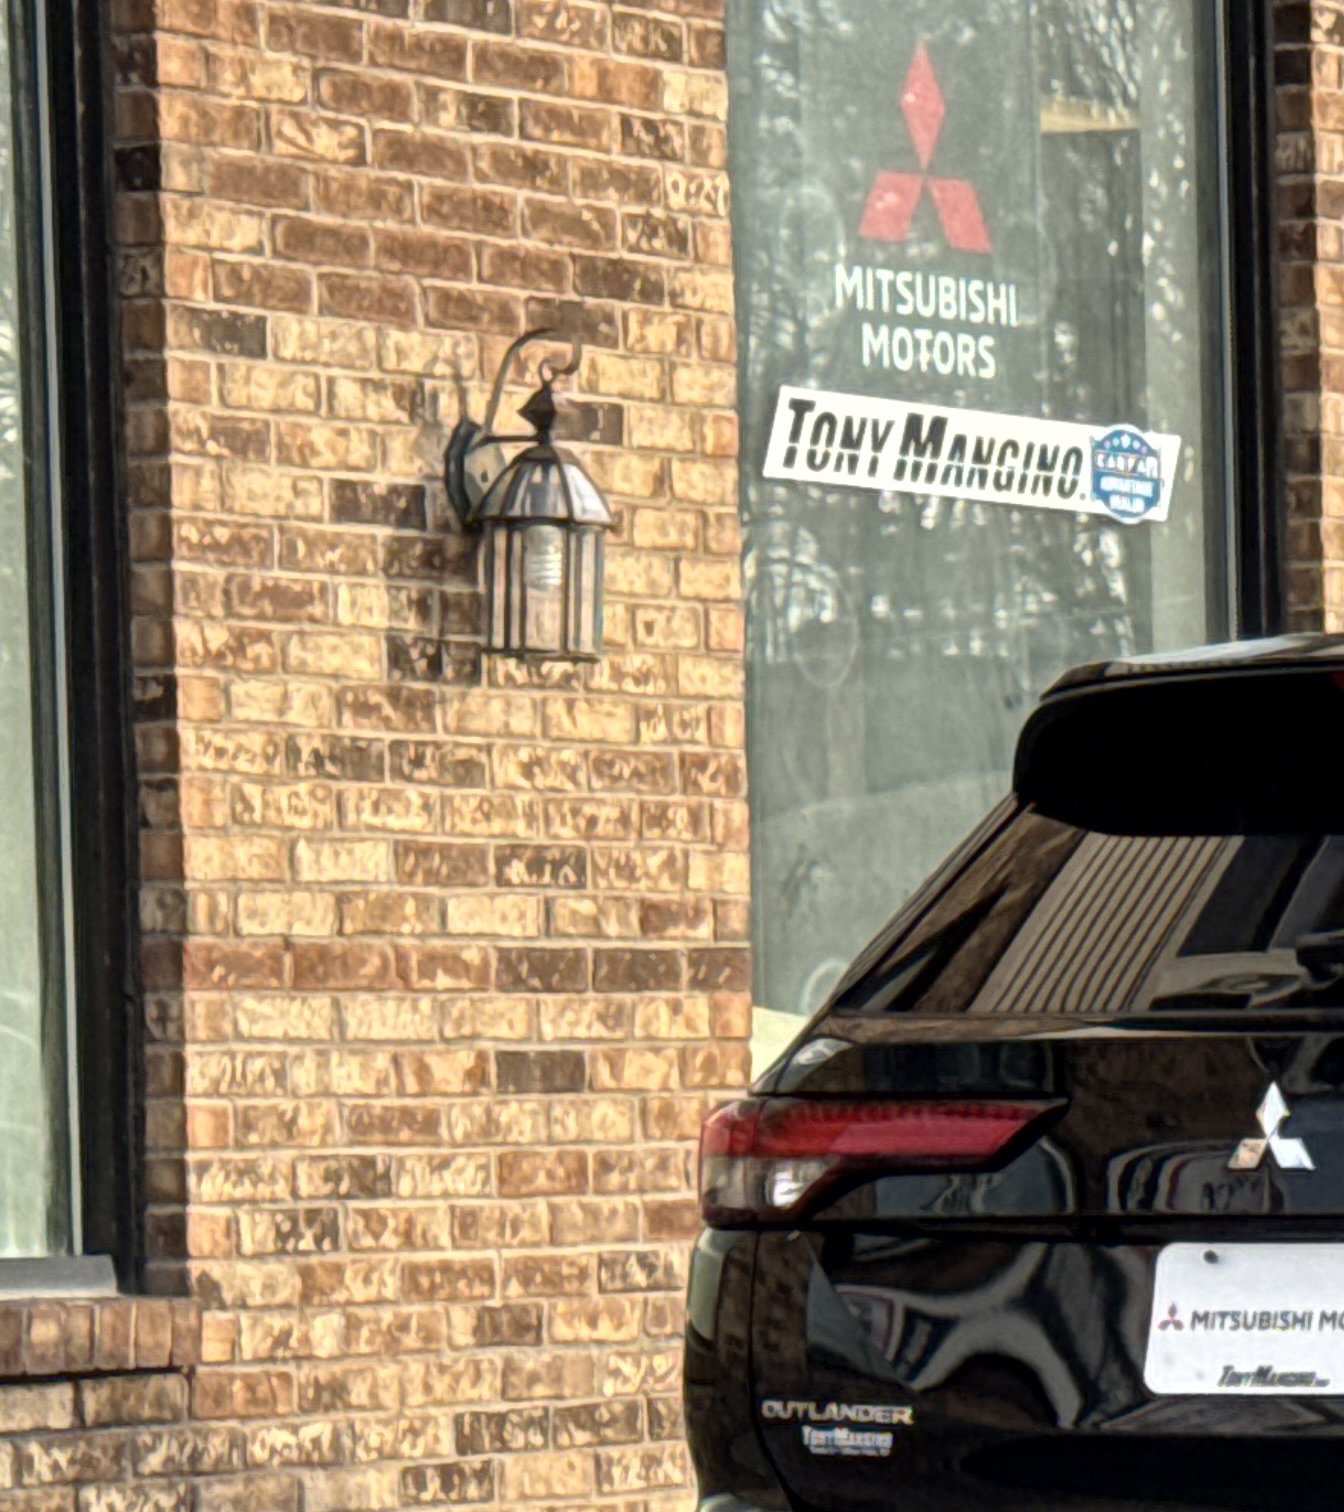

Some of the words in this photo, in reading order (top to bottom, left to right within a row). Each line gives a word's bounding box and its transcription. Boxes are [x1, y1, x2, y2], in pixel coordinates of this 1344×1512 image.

[833, 264, 1020, 328] MITSUBISHI
[860, 323, 998, 380] MOTORS
[782, 397, 895, 481] TONY
[1190, 1309, 1314, 1331] MITSUBISHI
[761, 1399, 915, 1426] OUTLANDER
